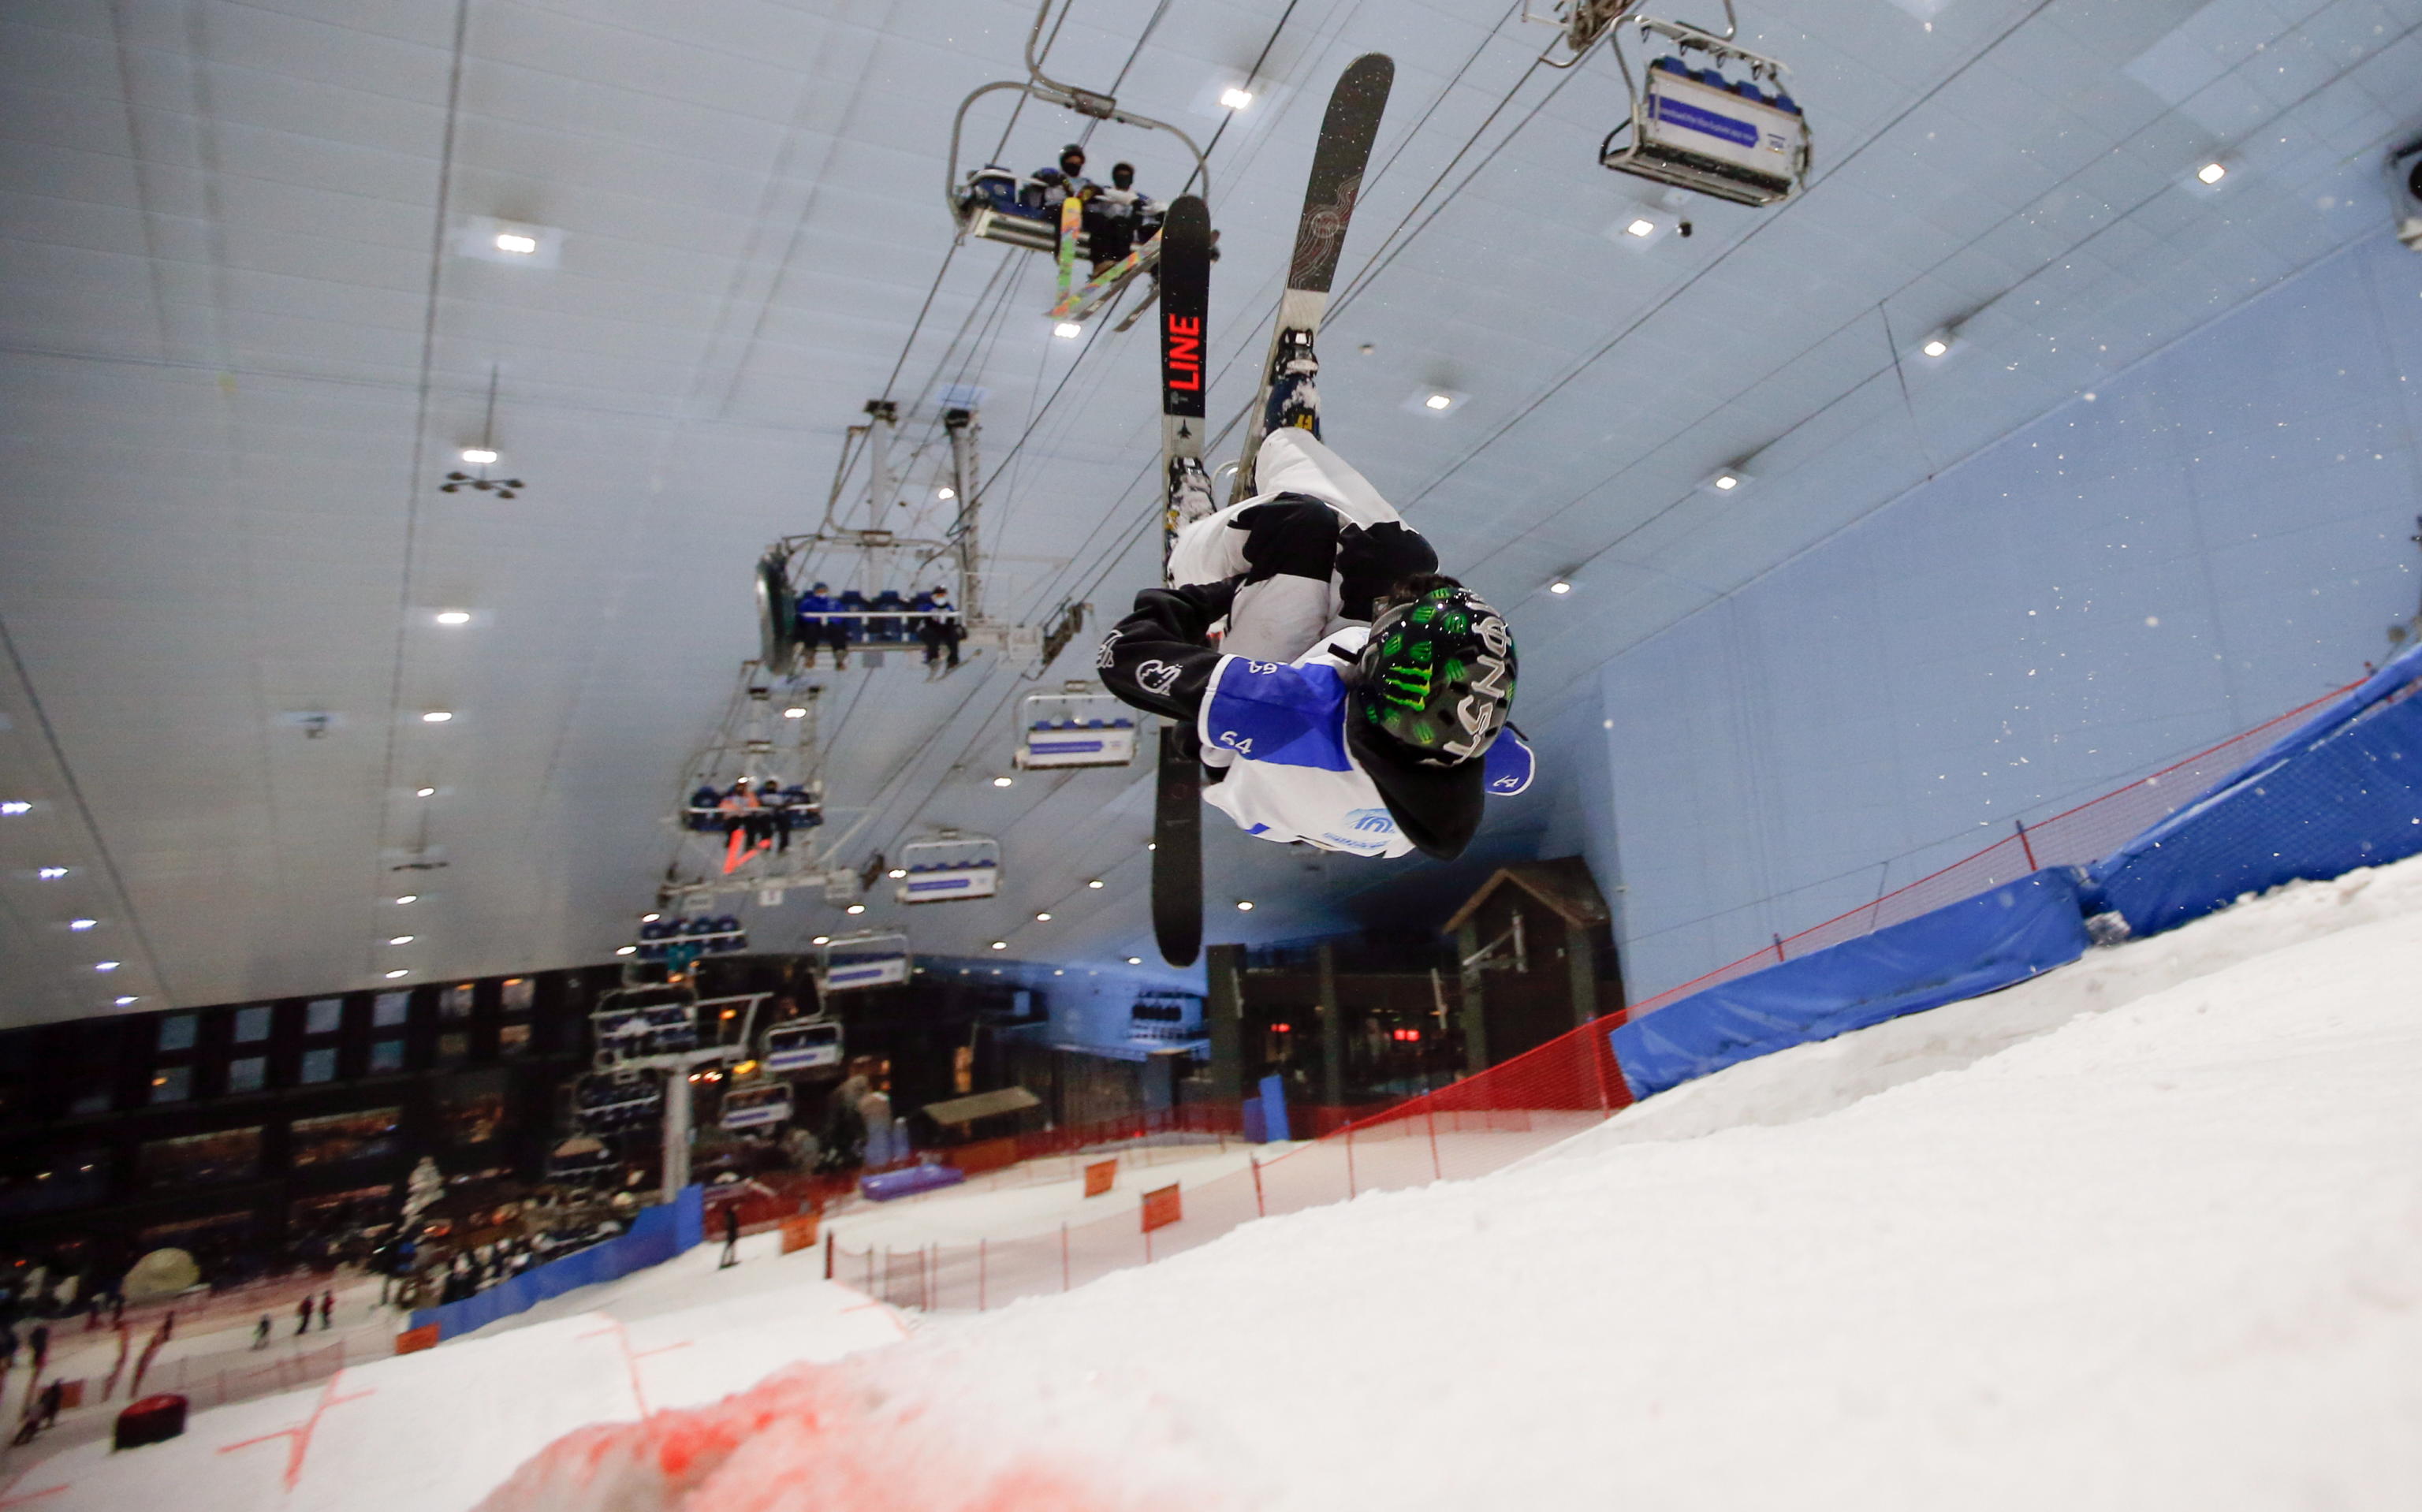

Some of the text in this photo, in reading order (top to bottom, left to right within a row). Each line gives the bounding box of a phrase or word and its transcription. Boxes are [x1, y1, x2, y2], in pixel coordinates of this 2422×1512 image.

[1169, 313, 1199, 391] LINE
[1248, 661, 1278, 675] 64
[1220, 731, 1254, 754] 64
